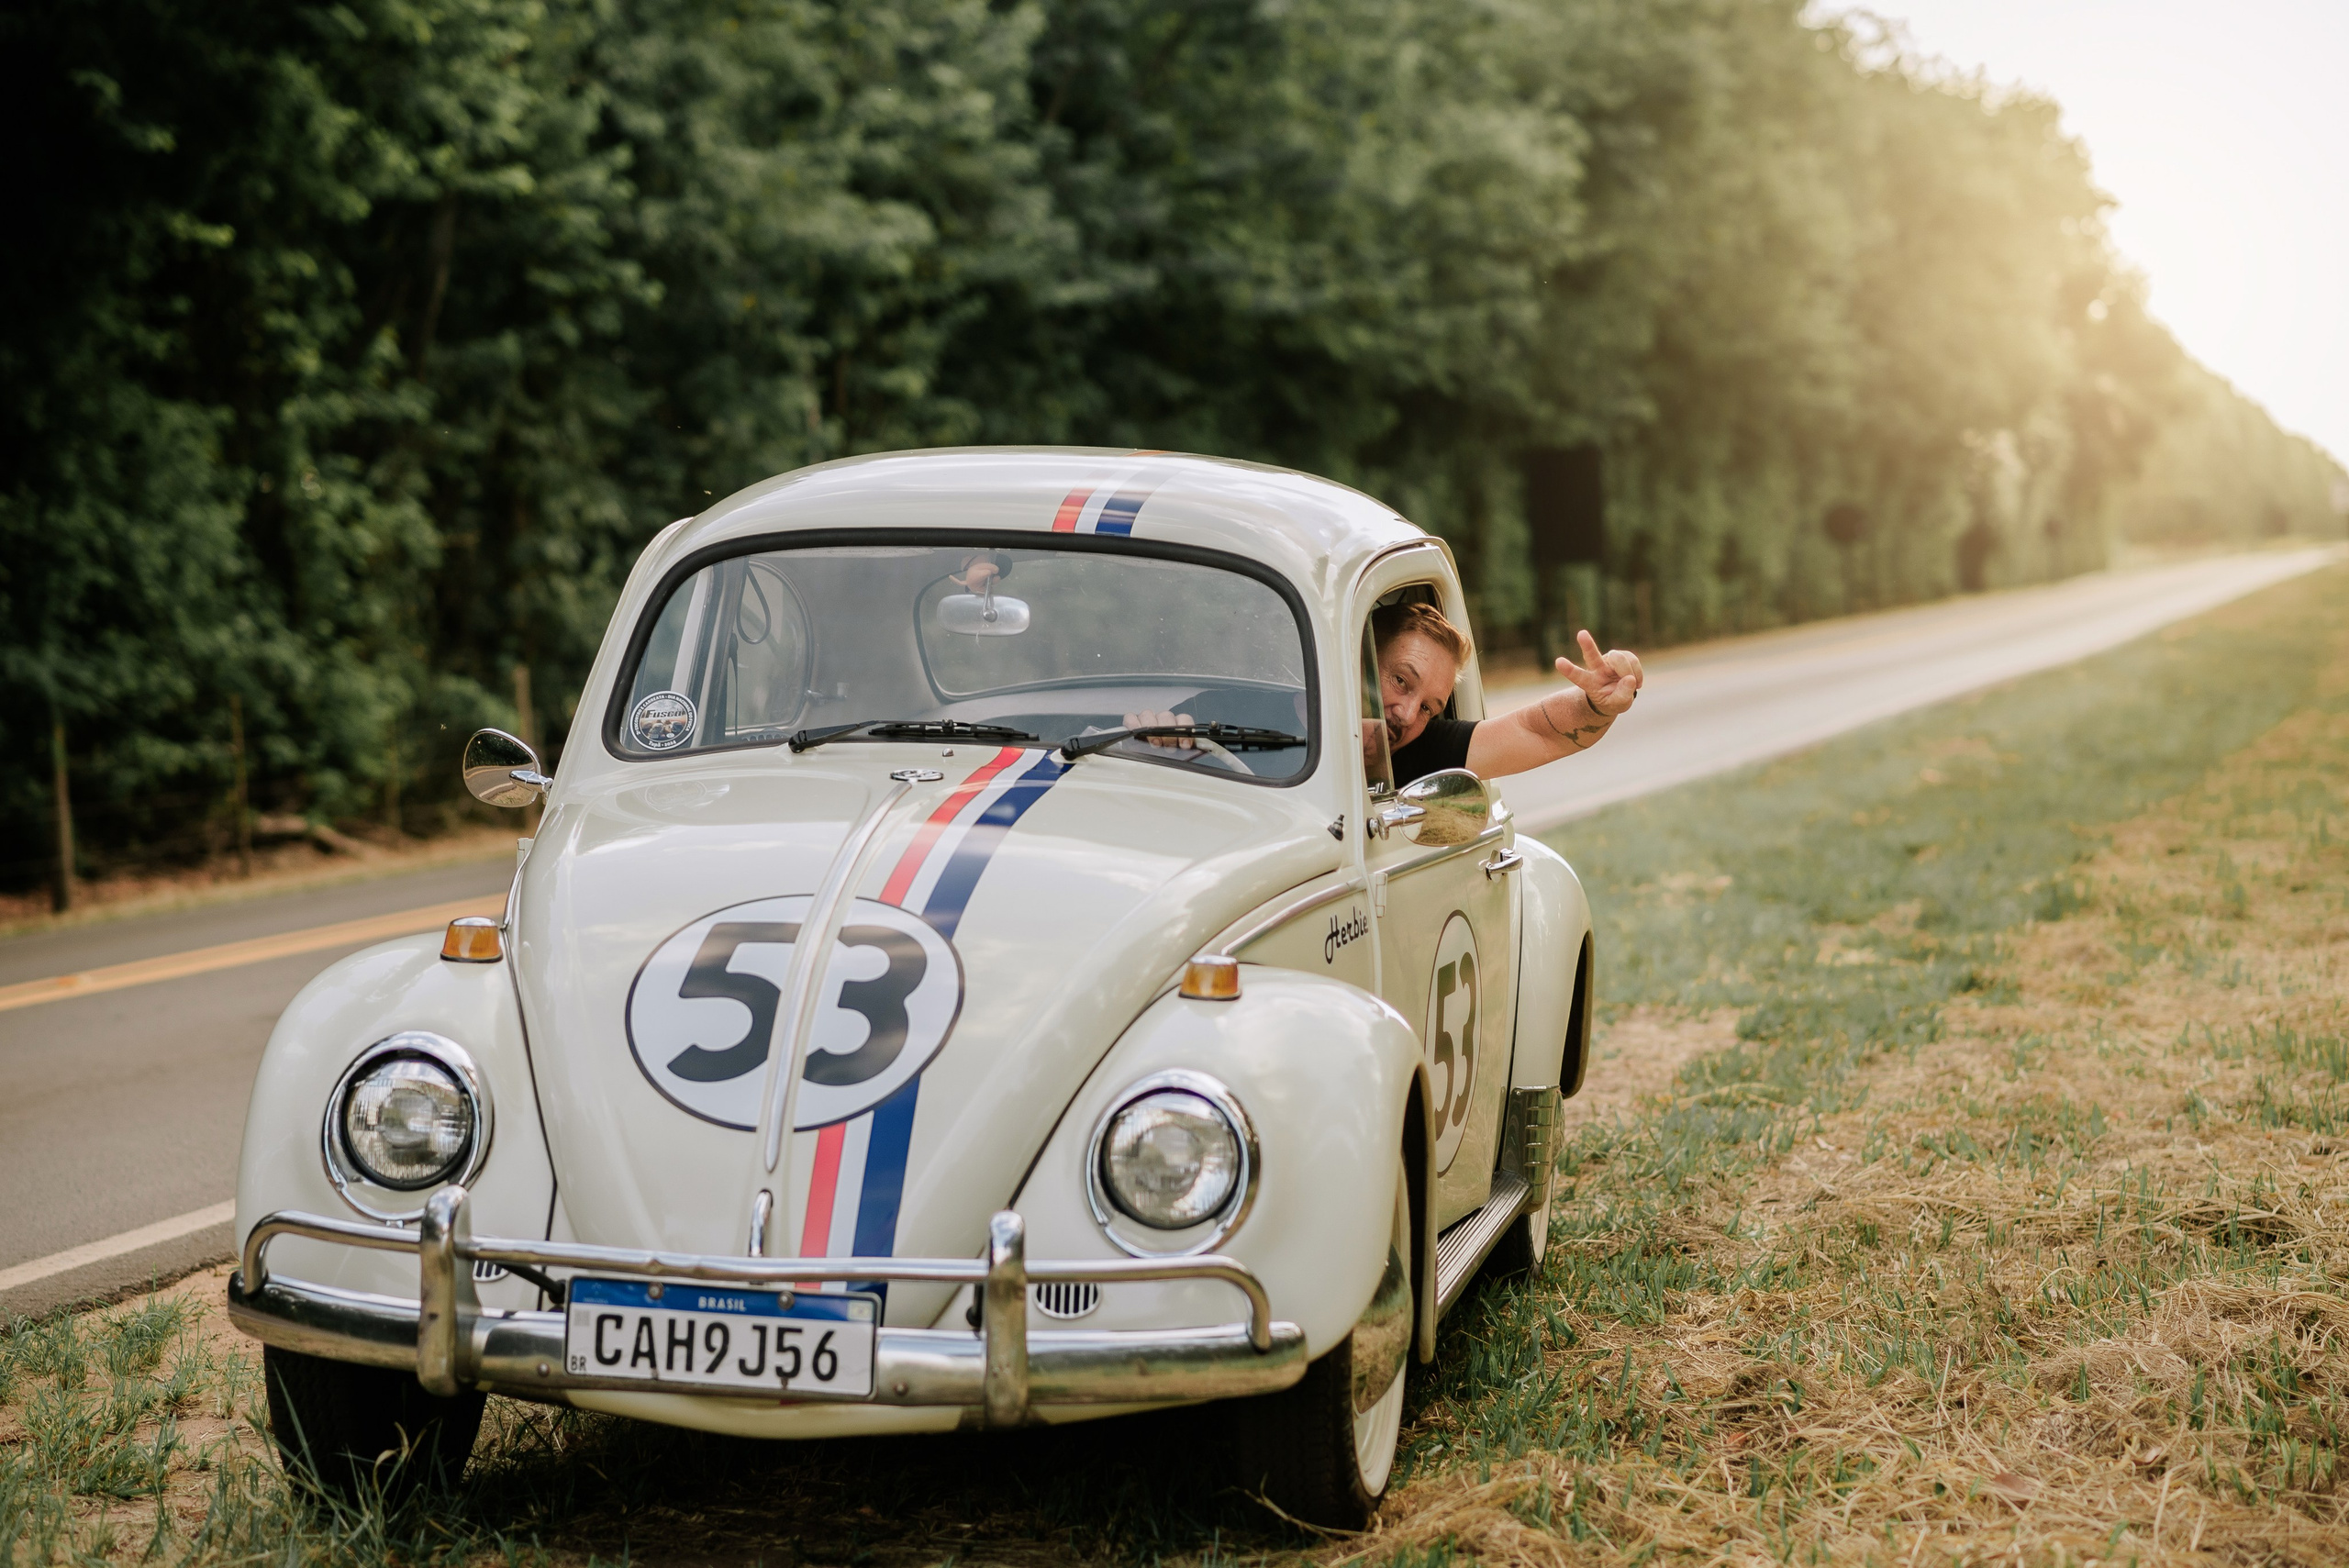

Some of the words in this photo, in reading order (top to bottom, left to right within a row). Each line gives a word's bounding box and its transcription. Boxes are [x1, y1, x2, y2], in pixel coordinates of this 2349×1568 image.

[645, 709, 682, 718] Fusca
[1325, 906, 1368, 964] Herbie
[667, 923, 927, 1086] 53
[1434, 951, 1476, 1142] 53
[698, 1296, 747, 1312] BRASIL
[571, 1354, 586, 1372] BR
[595, 1313, 839, 1382] CAH9J56
